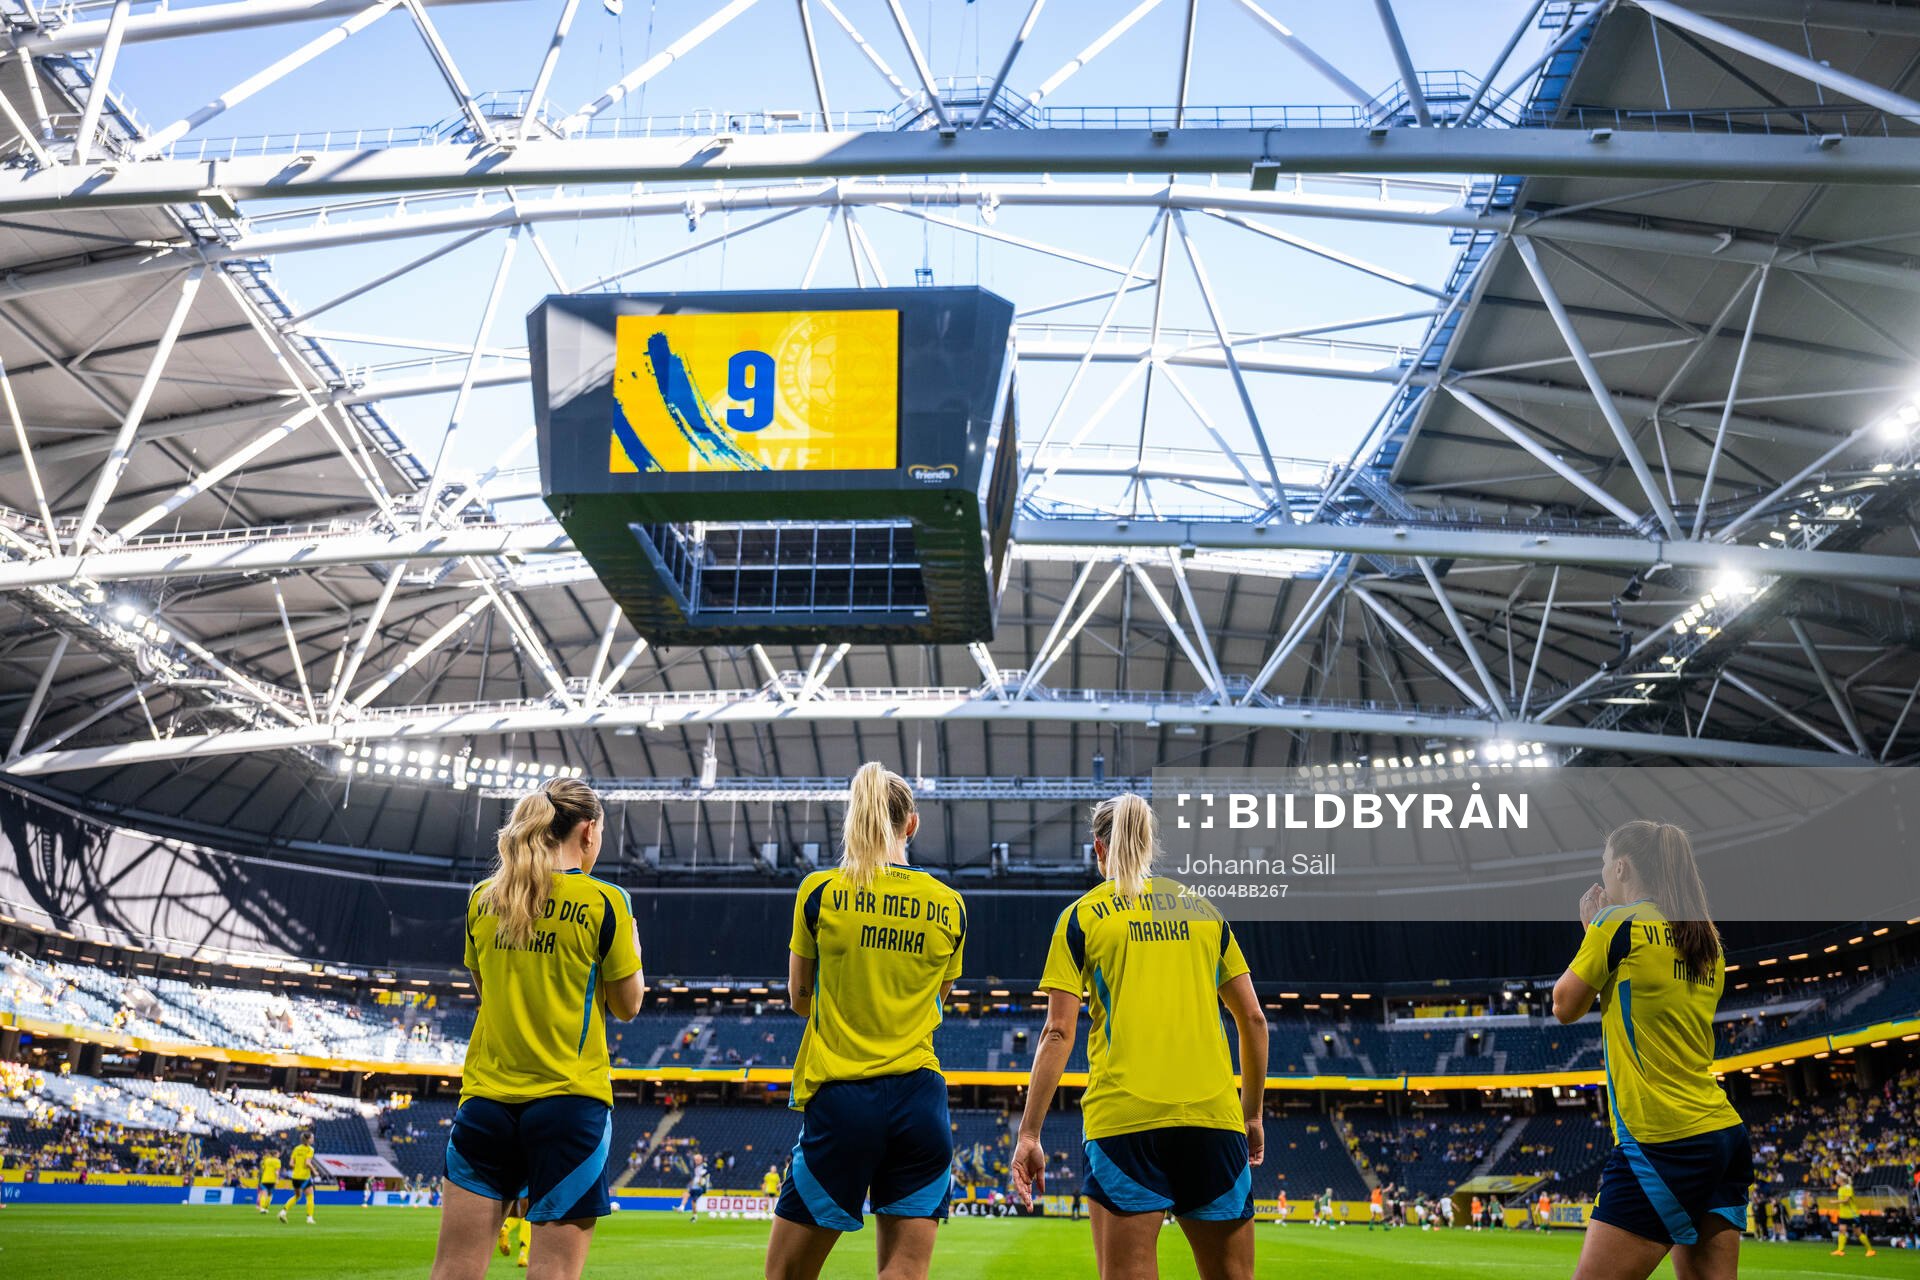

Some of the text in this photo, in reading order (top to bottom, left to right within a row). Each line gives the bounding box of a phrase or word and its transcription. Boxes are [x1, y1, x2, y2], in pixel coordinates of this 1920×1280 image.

[726, 350, 776, 433] 9
[833, 889, 848, 911] VI
[883, 894, 921, 919] MED
[1091, 901, 1110, 919] VI
[860, 924, 925, 954] MARIKA
[1128, 920, 1190, 942] MARIKA
[1643, 924, 1660, 946] VI
[1673, 958, 1716, 989] MAA
